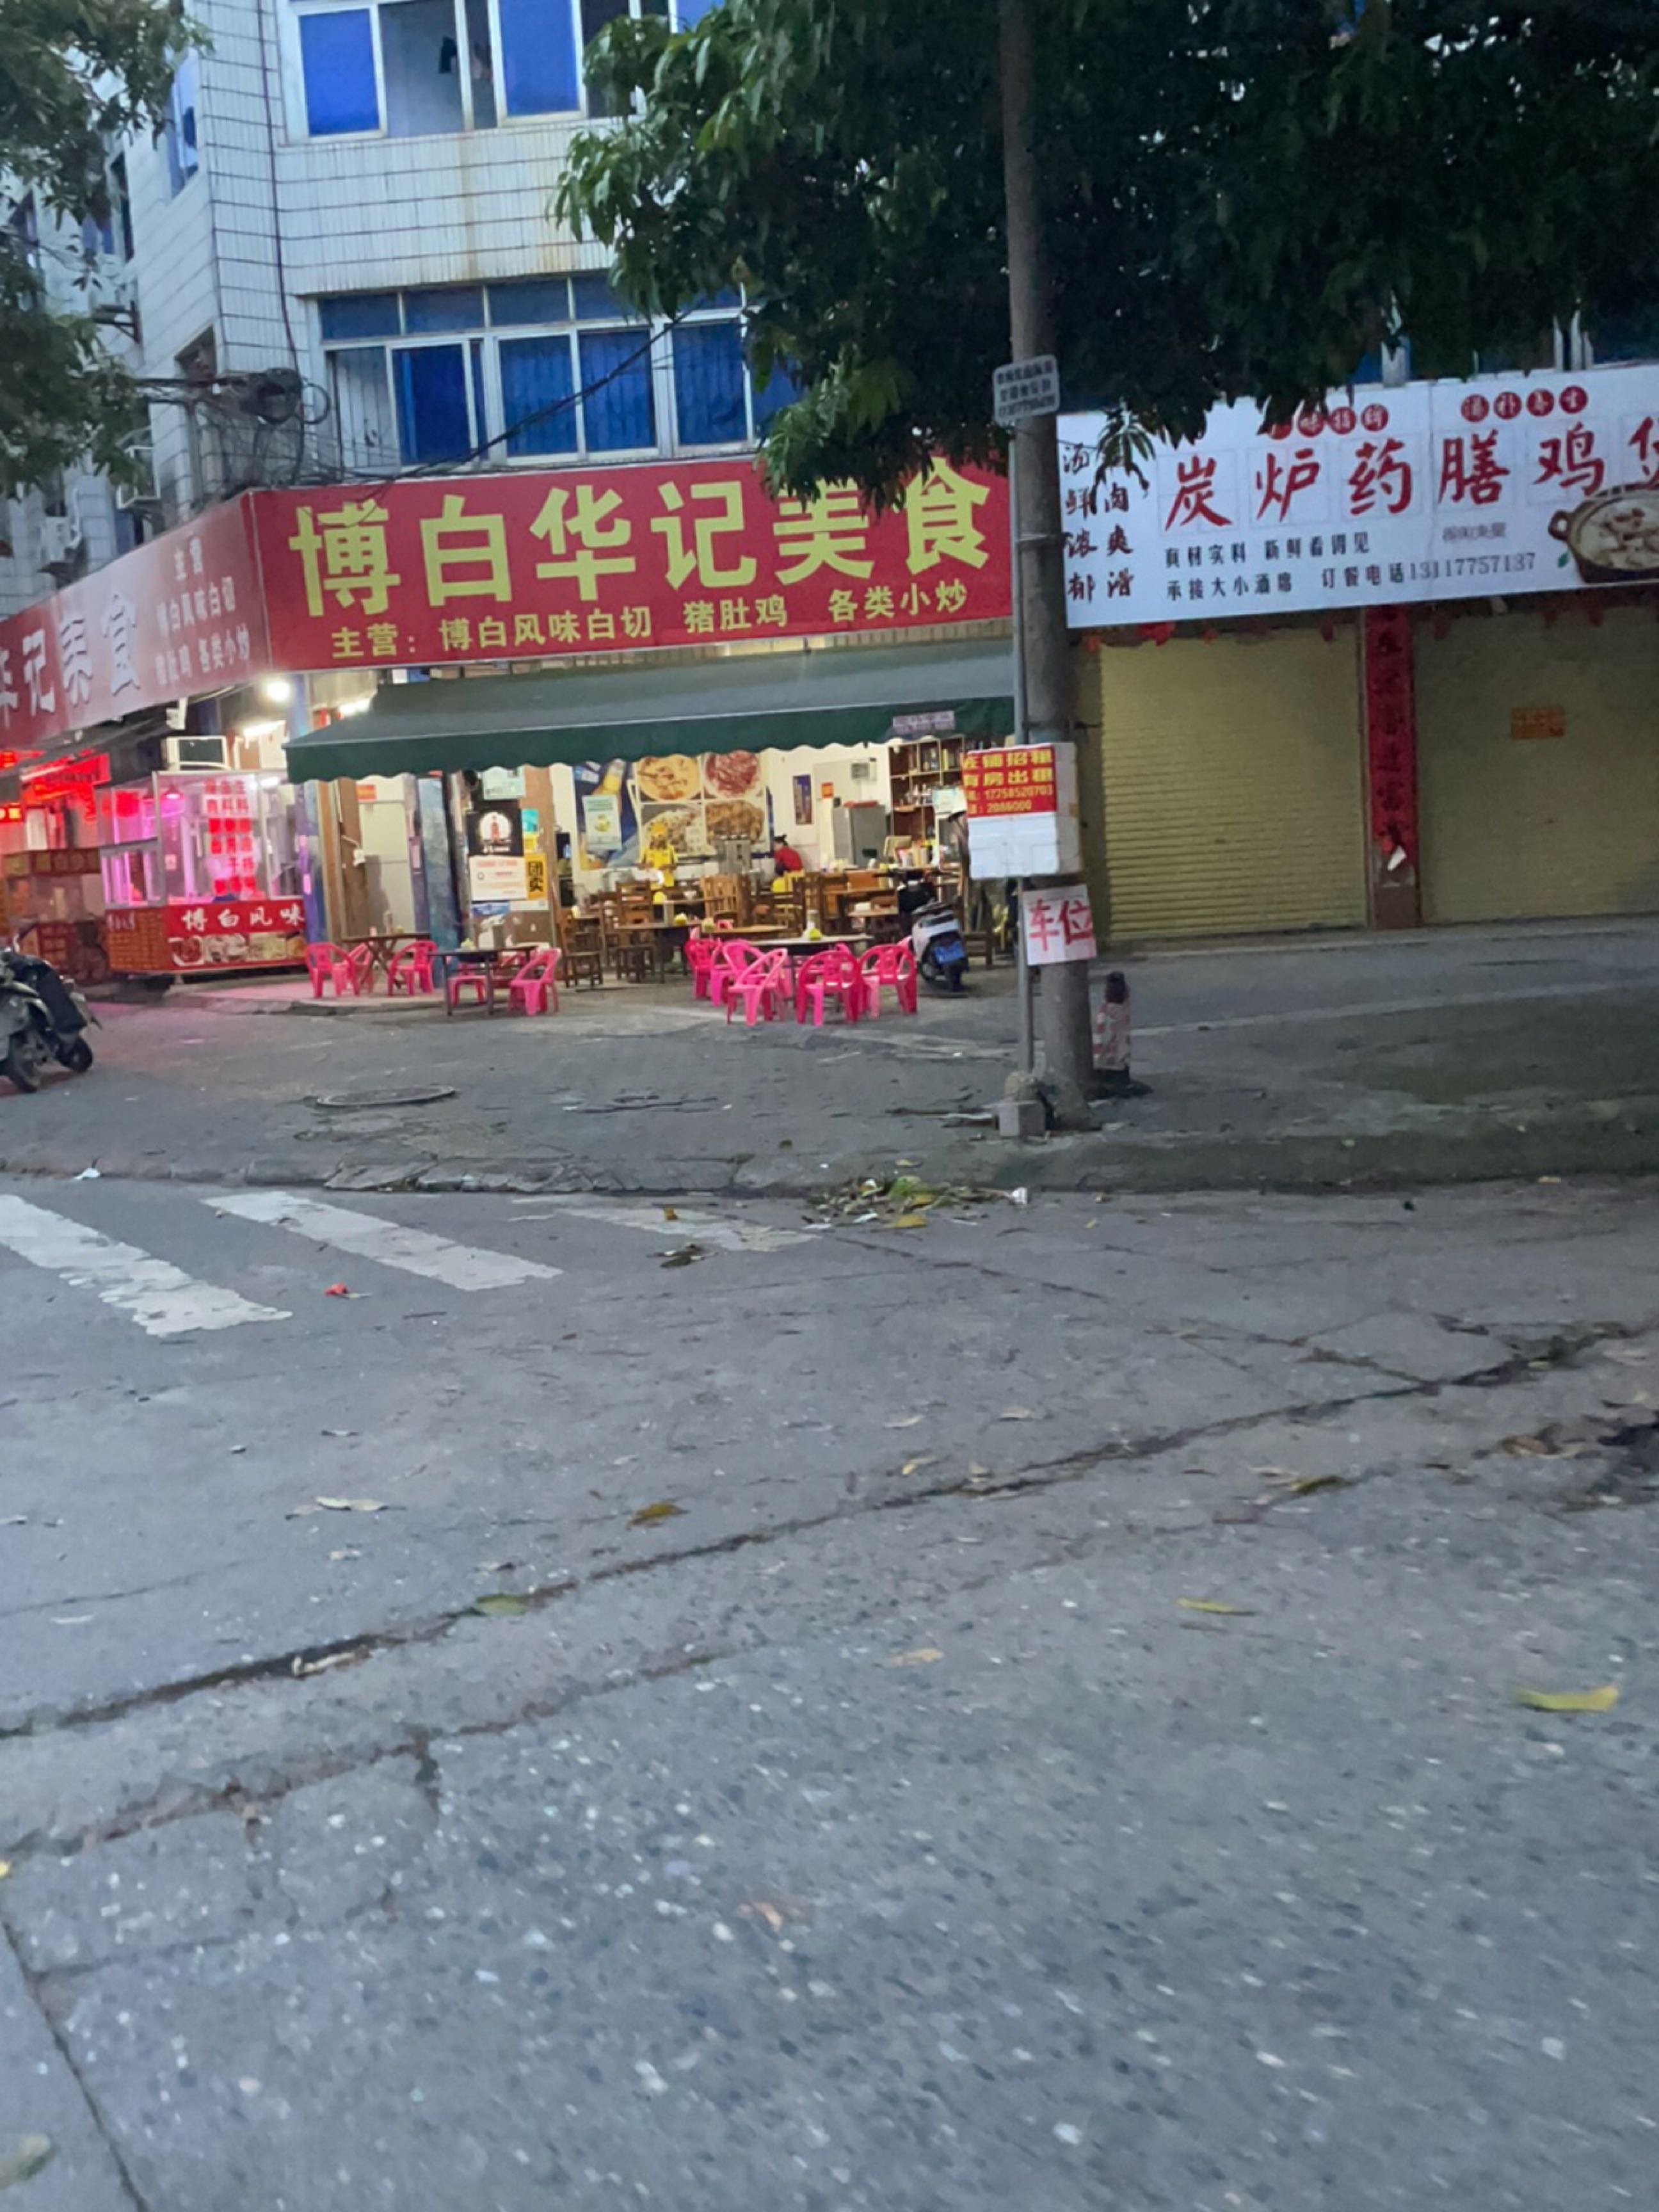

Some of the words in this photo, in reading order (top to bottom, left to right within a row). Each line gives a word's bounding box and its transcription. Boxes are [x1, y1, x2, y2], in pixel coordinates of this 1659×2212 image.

[289, 457, 991, 618] 博白华记美食
[1165, 541, 1246, 568] 真材实料
[1263, 531, 1370, 561] 新鲜看得见
[1167, 572, 1292, 601] 承接大小酒席
[438, 607, 652, 652] 博白风味白切
[684, 595, 788, 634] 猪肚鸡
[828, 579, 968, 623] 各类小炒
[182, 902, 305, 931] 博白风味
[1029, 899, 1093, 952] 车位
